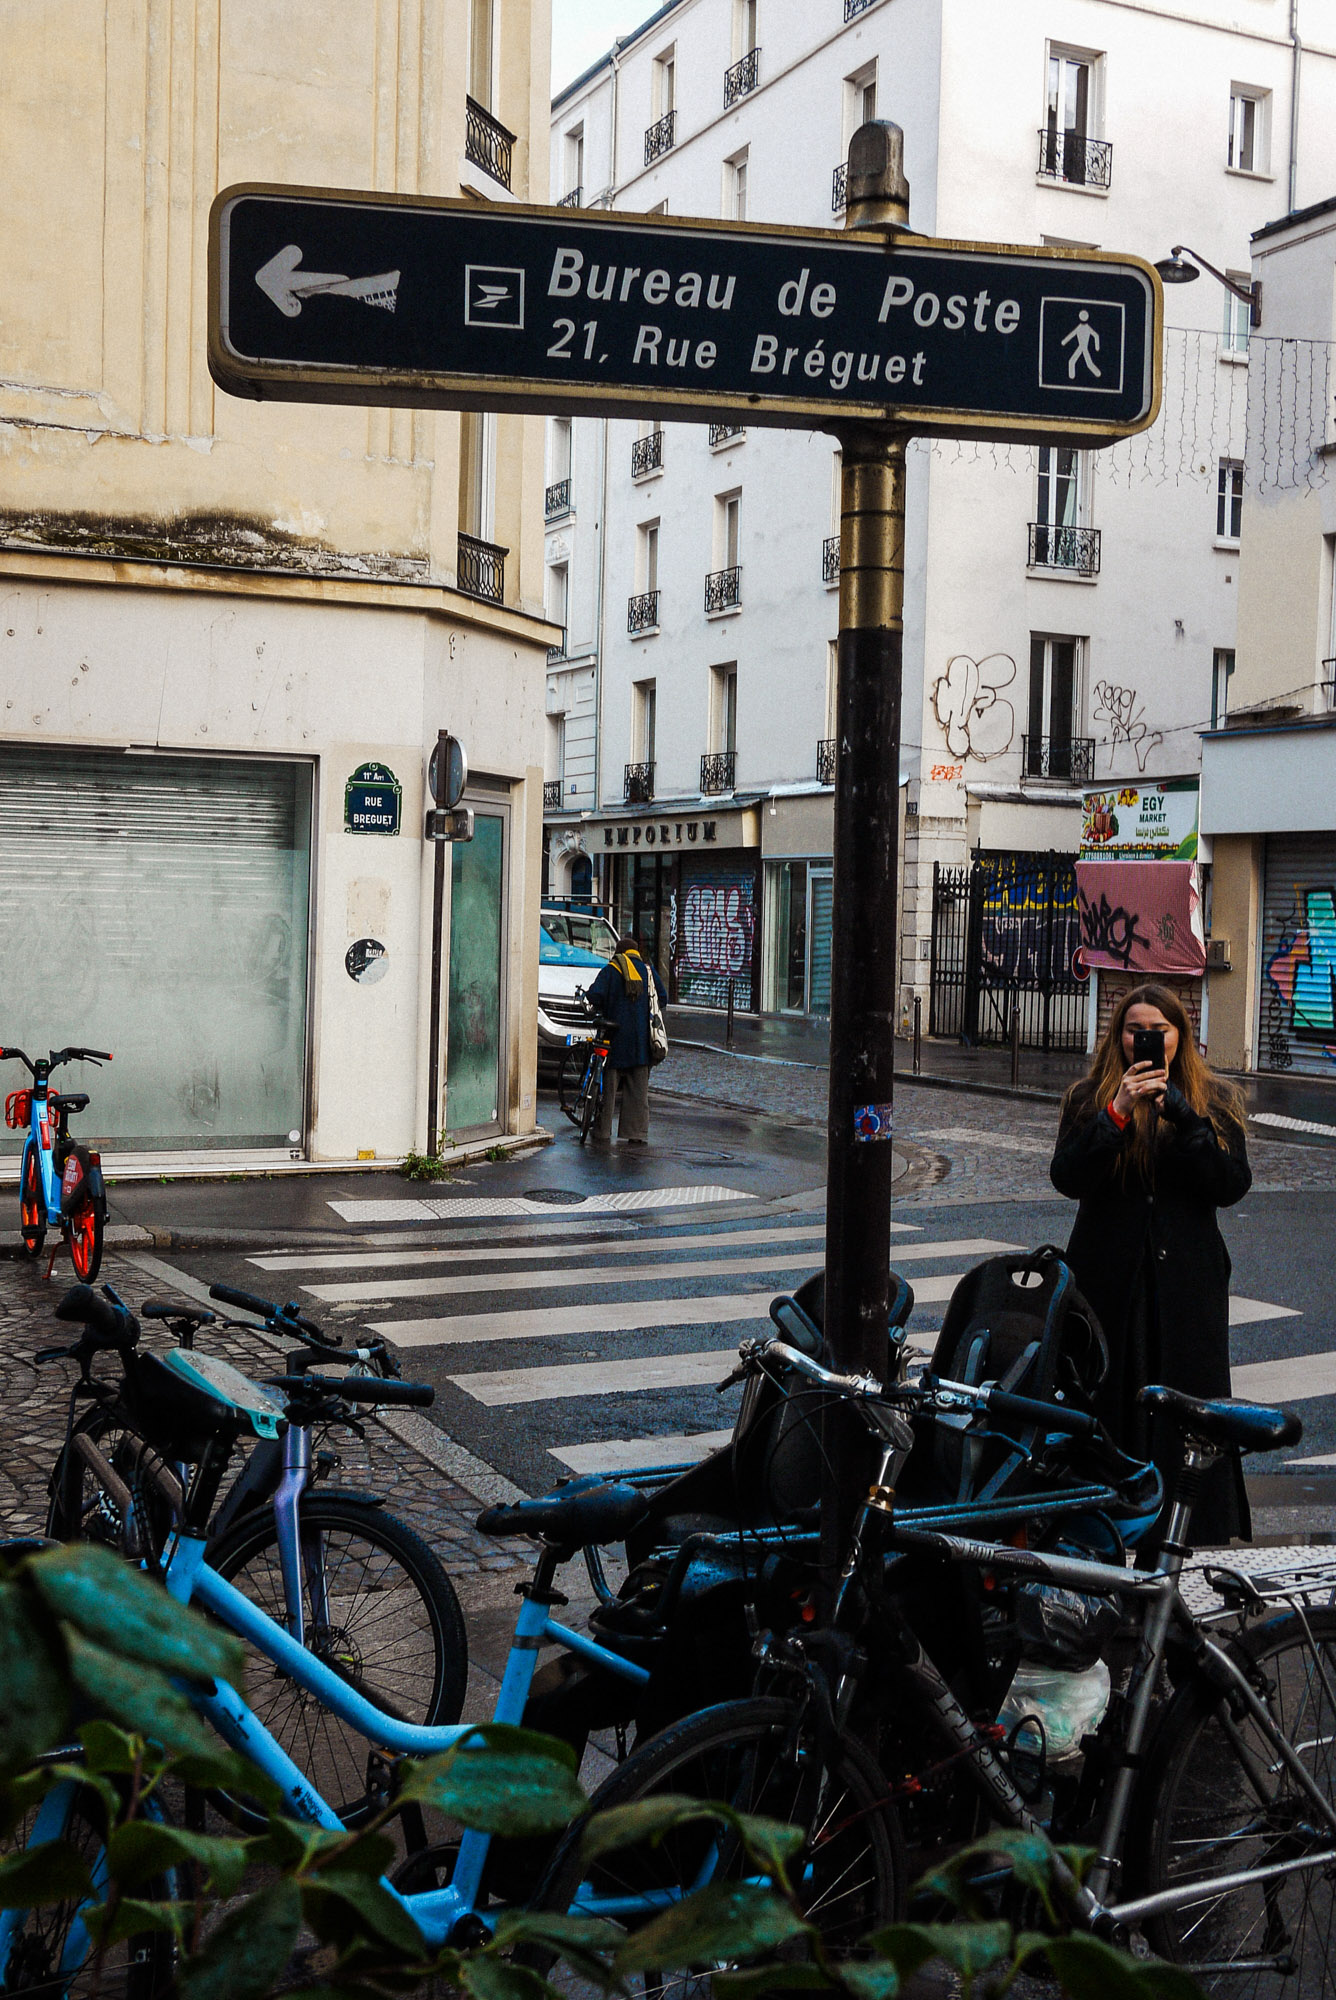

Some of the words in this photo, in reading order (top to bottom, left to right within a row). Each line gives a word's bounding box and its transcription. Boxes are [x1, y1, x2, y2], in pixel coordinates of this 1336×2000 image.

[548, 247, 737, 310] Bureau
[778, 268, 837, 318] de
[878, 275, 1021, 334] Poste
[547, 319, 609, 364] 21,
[633, 326, 717, 369] Rue
[751, 335, 927, 390] Bréguet
[364, 796, 383, 807] RUE
[1142, 796, 1165, 811] EGY
[353, 814, 393, 825] BREGUET
[1139, 813, 1167, 822] MARKET
[603, 821, 717, 847] EMPORIUM
